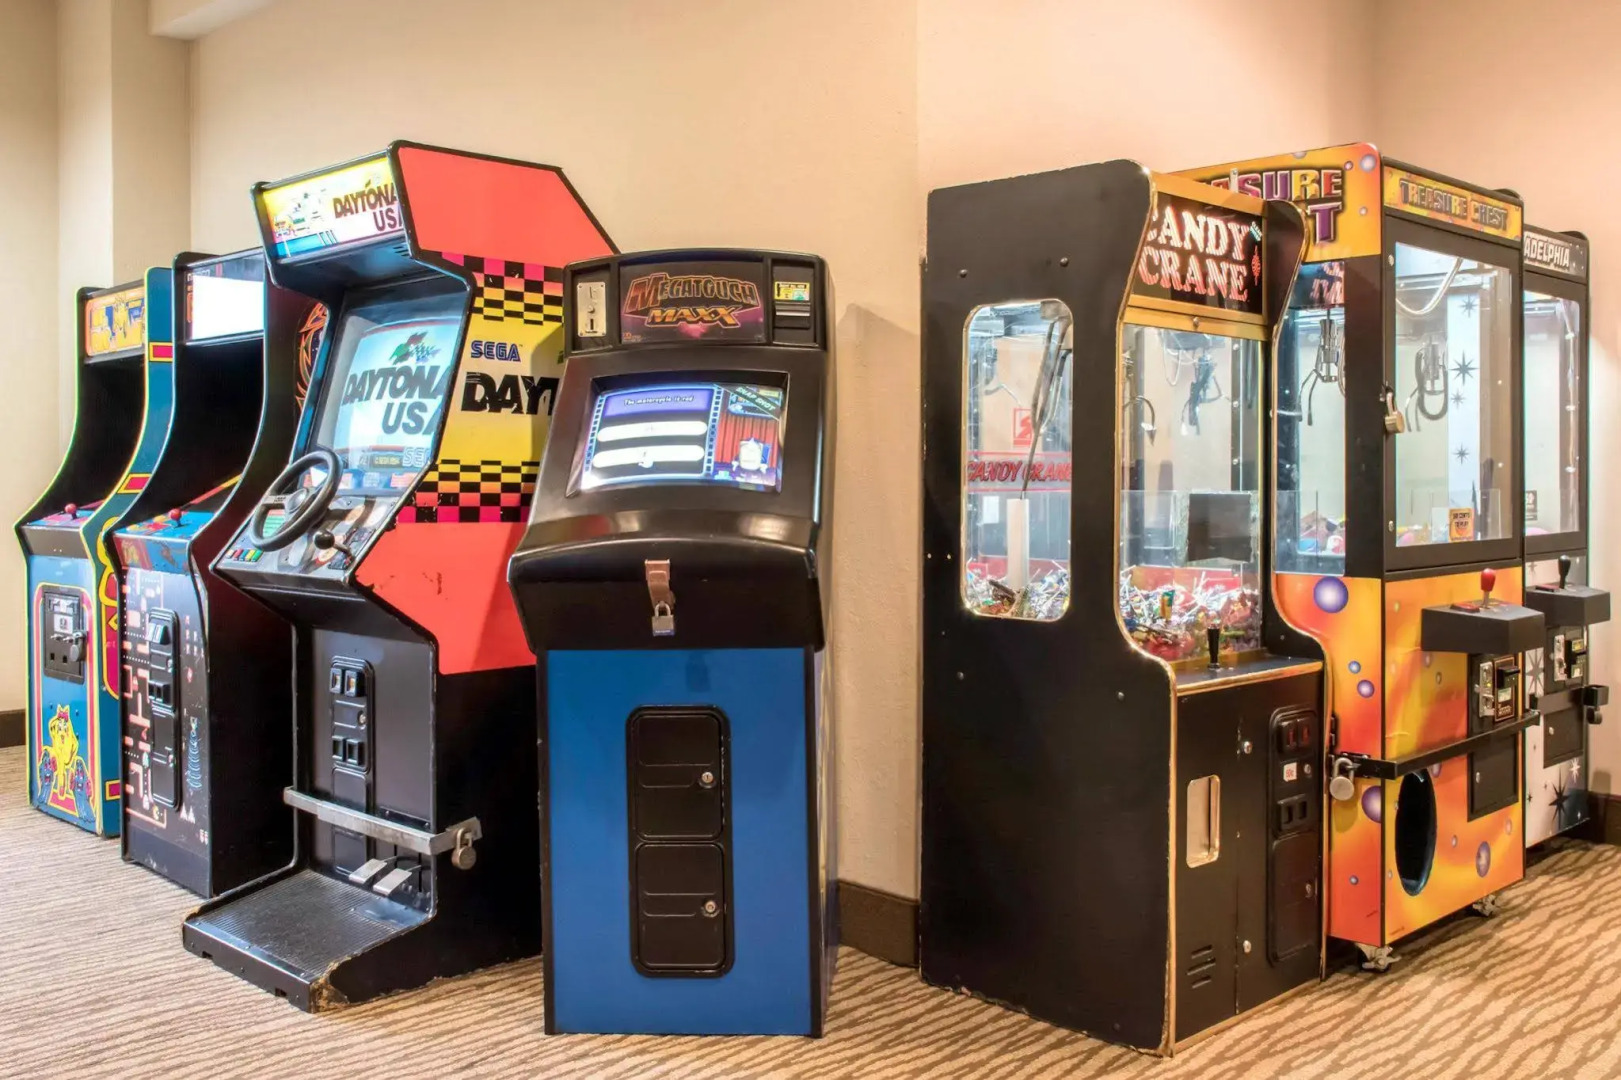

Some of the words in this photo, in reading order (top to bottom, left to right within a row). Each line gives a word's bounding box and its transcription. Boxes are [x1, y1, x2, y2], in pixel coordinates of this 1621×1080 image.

[1400, 181, 1468, 218] TREASURE
[1470, 200, 1508, 231] CHEST
[1139, 245, 1248, 302] CRANE
[625, 272, 760, 313] MEGATOUCH
[647, 305, 742, 327] MAXX
[470, 340, 521, 362] SEGA
[402, 447, 430, 469] SE
[967, 460, 1023, 482] CANDY
